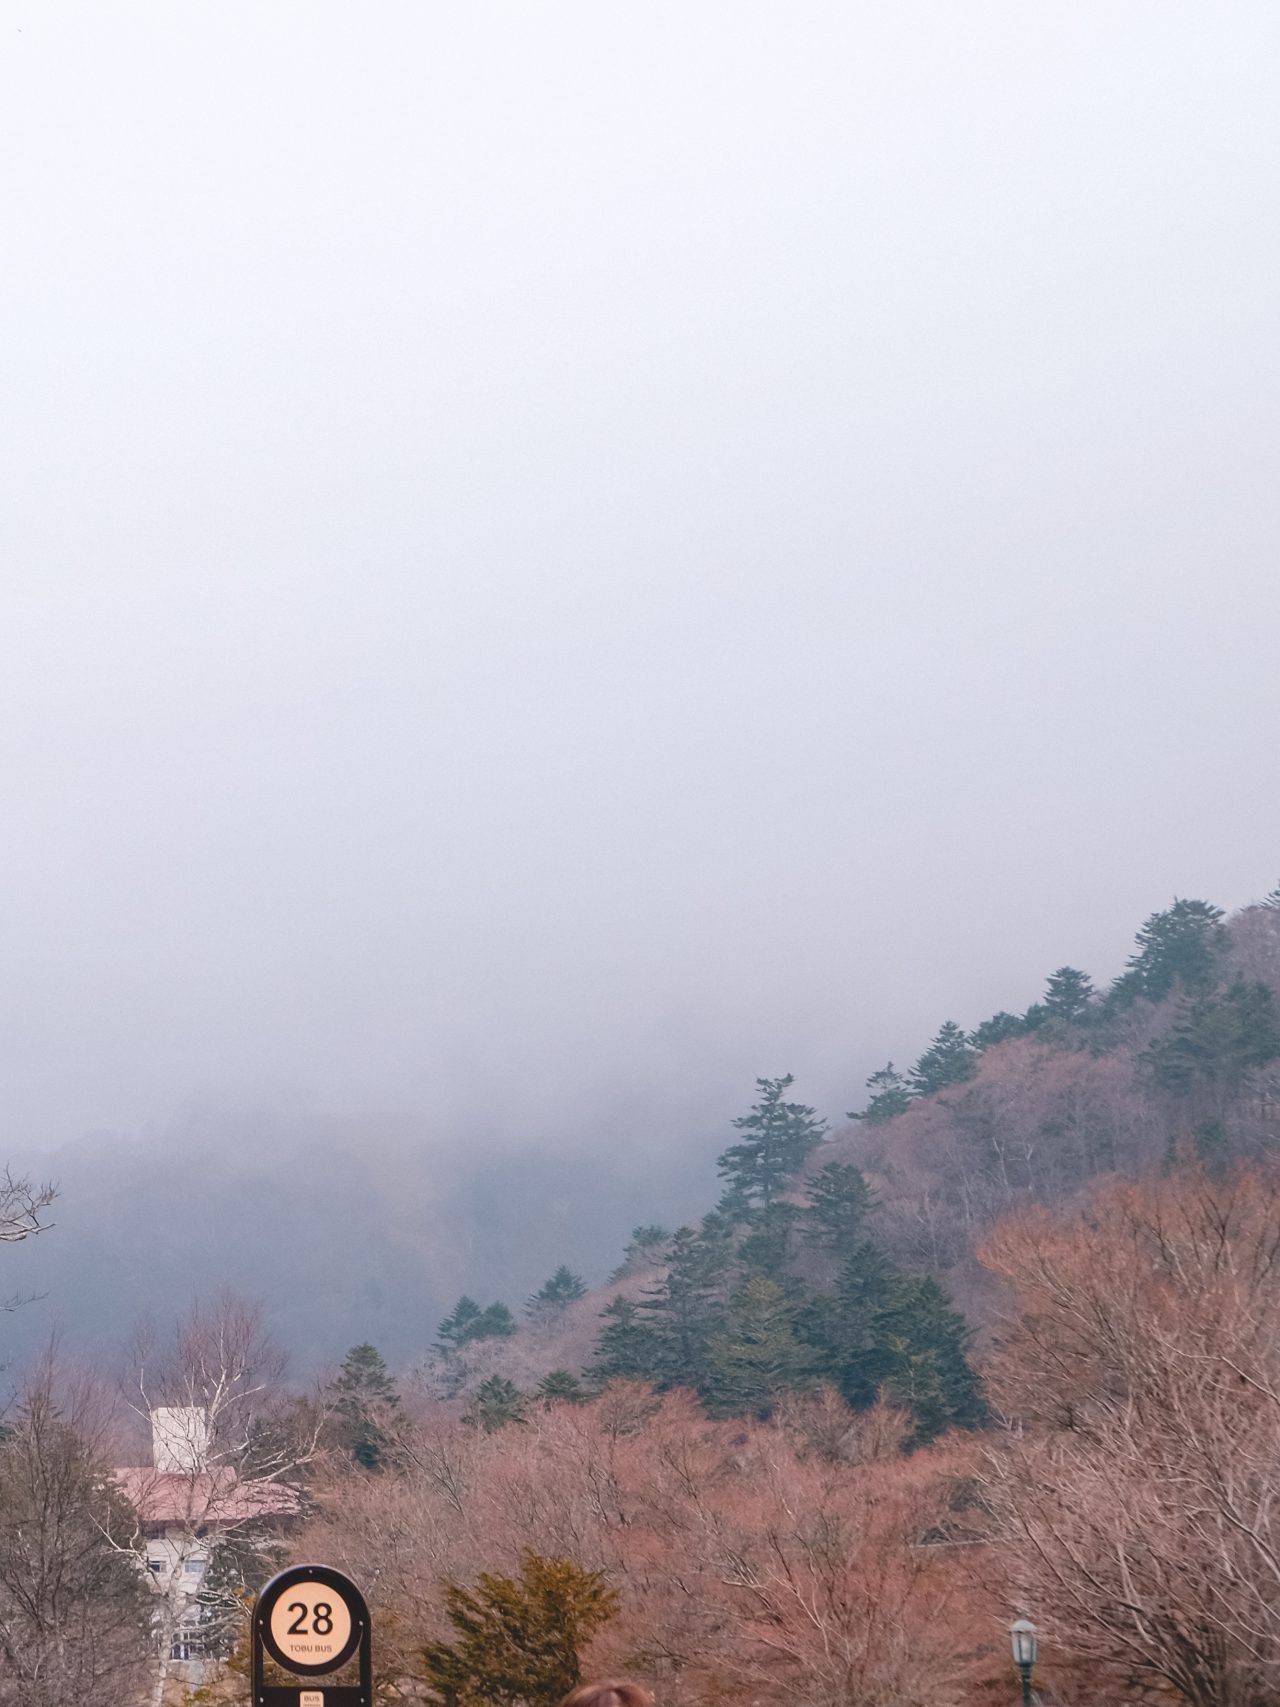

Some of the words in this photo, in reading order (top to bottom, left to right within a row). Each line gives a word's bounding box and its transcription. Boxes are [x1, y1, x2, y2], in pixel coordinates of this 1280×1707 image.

[287, 1602, 333, 1636] 28
[290, 1644, 313, 1652] TOBU
[314, 1644, 332, 1652] BUS
